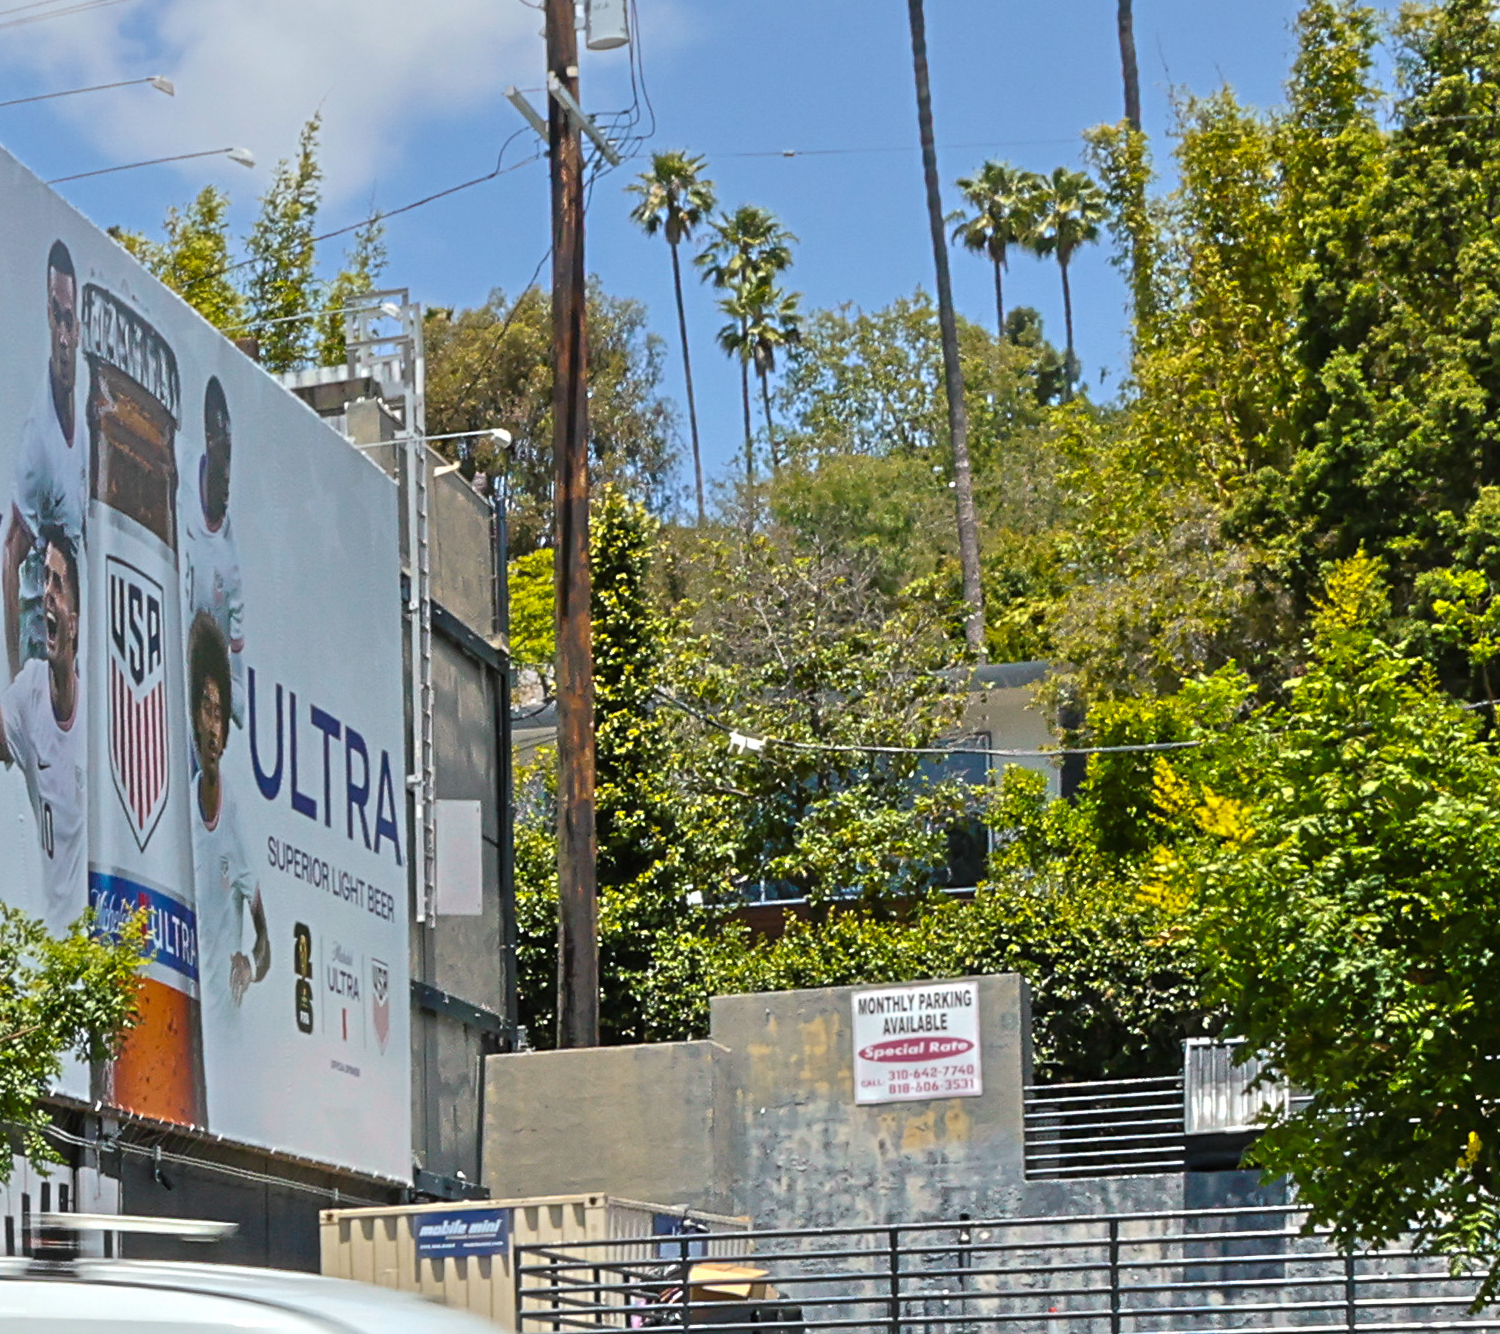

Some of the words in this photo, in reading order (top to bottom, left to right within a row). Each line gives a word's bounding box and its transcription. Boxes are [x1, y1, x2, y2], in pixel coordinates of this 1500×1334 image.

[110, 574, 162, 686] USA
[248, 666, 402, 867] ULTRA
[267, 835, 330, 893] SUPERIOR
[332, 866, 365, 908] LIGHT
[367, 884, 395, 924] BEER
[858, 994, 915, 1015] MONTHLY
[919, 990, 972, 1010] PARKING
[883, 1013, 948, 1035] AVAILABLE
[864, 1041, 924, 1061] Special
[929, 1040, 968, 1052] Rate
[888, 1064, 975, 1081] 310-642-7740
[419, 1219, 468, 1236] mobile
[468, 1218, 504, 1234] mini
